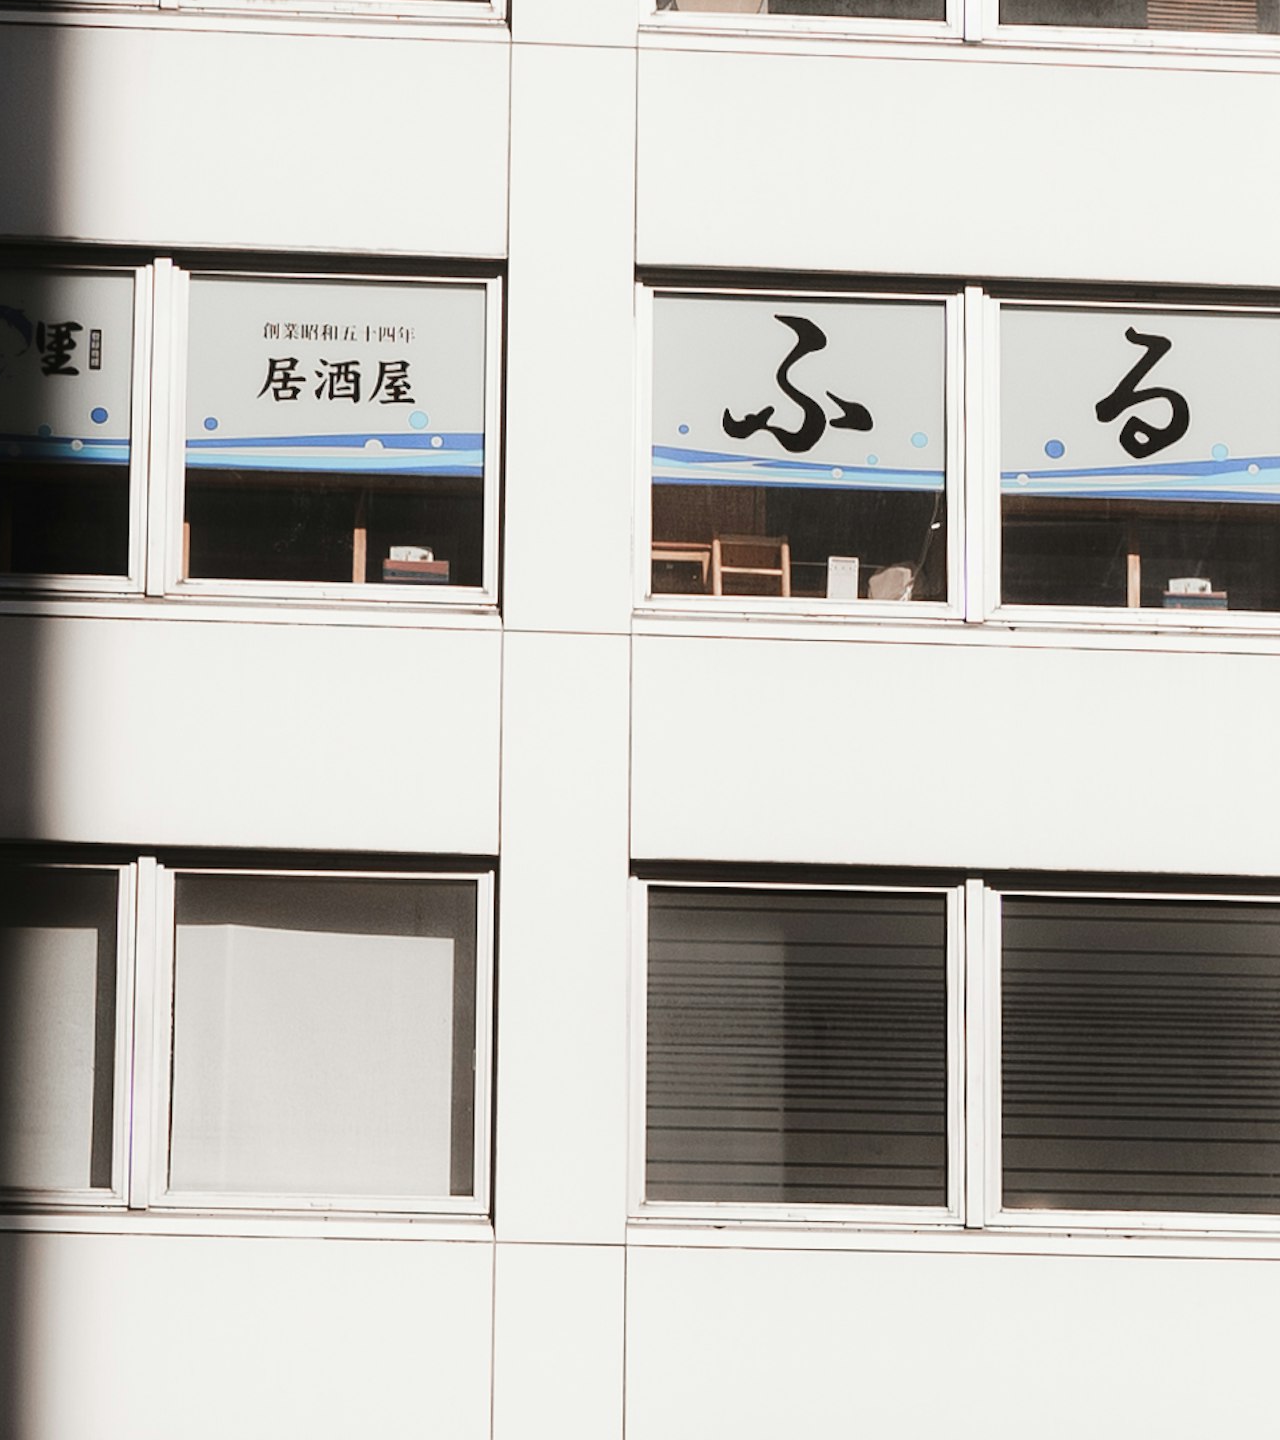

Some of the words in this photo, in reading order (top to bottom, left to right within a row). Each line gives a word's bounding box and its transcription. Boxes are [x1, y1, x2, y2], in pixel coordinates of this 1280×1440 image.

[262, 321, 416, 343] 創業昭和五十四年
[257, 356, 417, 406] 居酒屋
